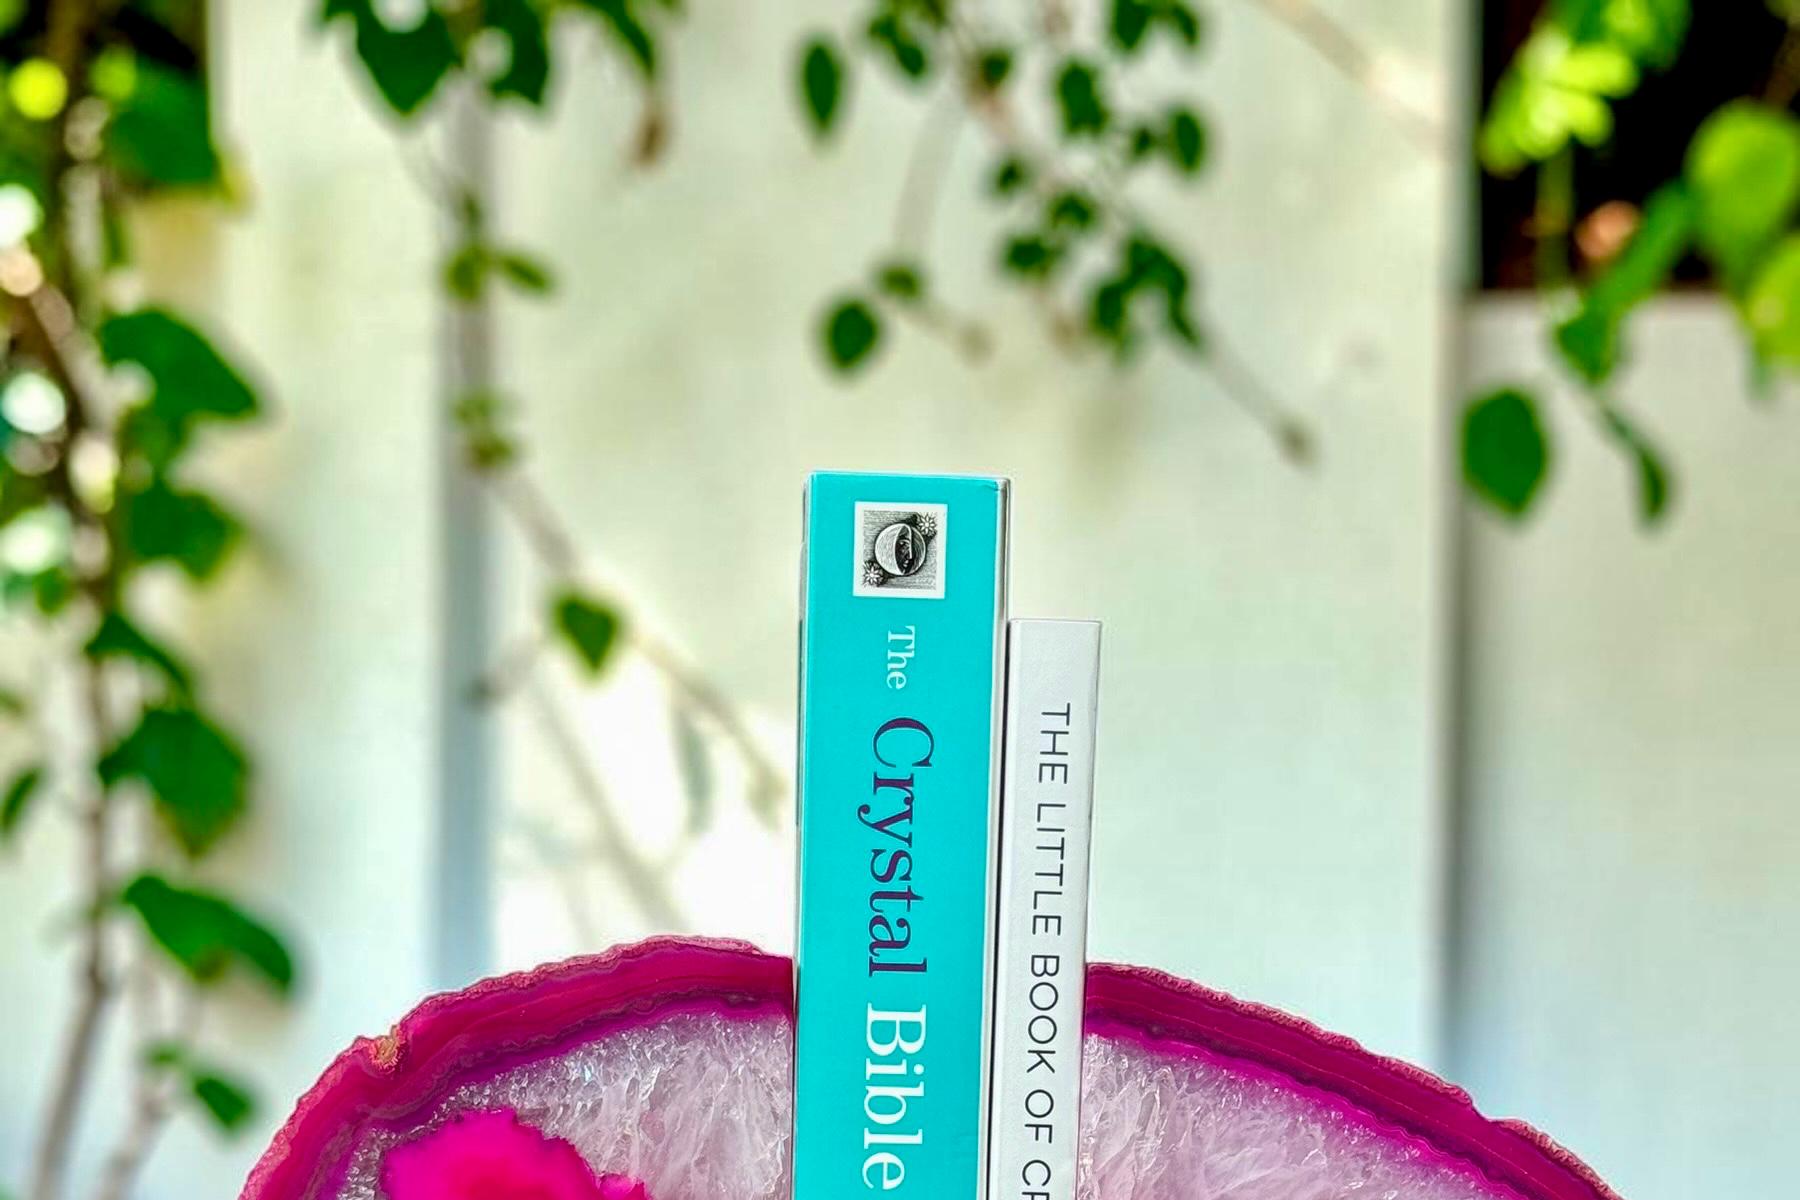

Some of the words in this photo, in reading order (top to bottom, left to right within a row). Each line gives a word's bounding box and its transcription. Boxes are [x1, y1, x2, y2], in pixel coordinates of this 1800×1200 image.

[886, 624, 916, 690] The
[1038, 702, 1071, 785] THE
[857, 716, 935, 977] Crystal
[1031, 803, 1067, 936] LITTLE
[1026, 954, 1061, 1074] BOOK
[861, 1002, 928, 1191] Bible
[1024, 1088, 1055, 1144] OF
